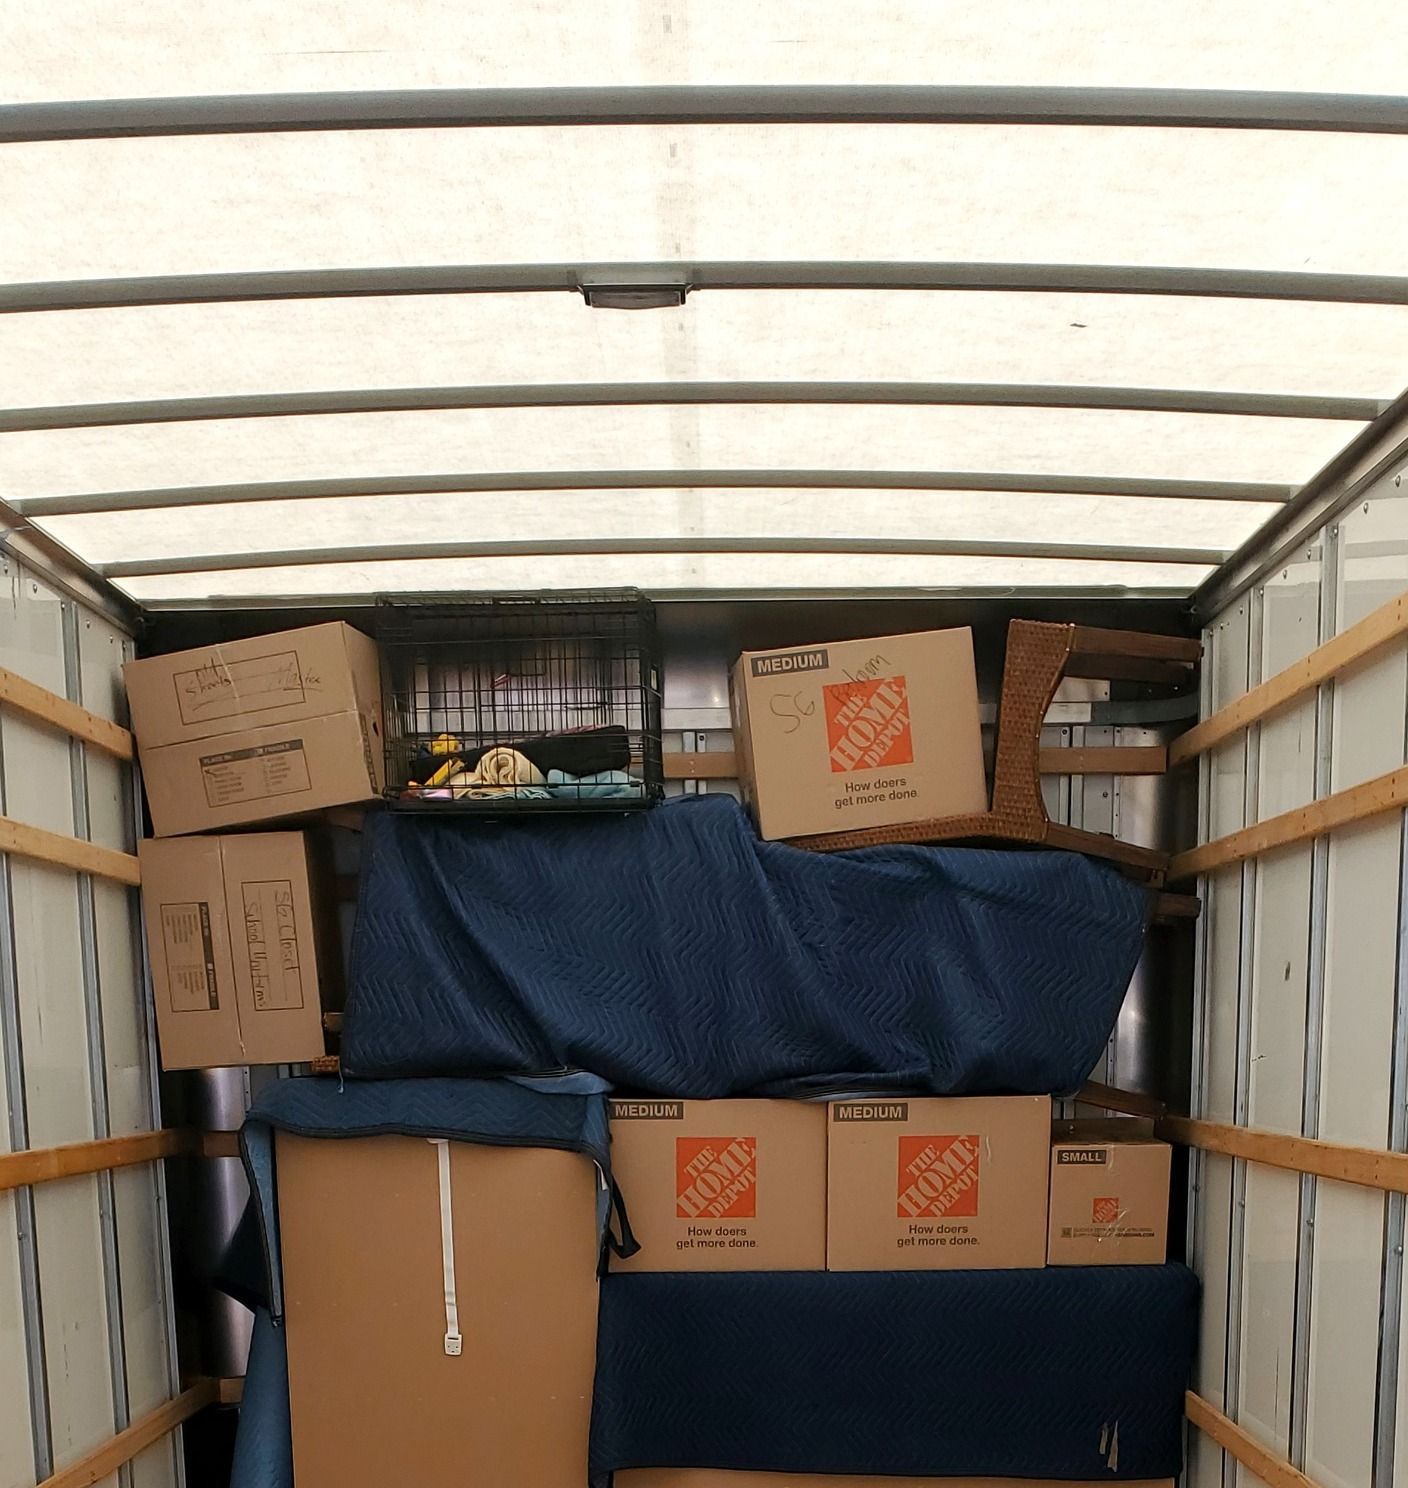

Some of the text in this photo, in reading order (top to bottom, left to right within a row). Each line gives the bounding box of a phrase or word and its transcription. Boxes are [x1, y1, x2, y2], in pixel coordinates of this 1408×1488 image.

[757, 653, 823, 674] MEDIUM
[834, 692, 868, 727] THE
[830, 678, 906, 771] HOME
[863, 709, 910, 768] DEPOT
[845, 777, 907, 793] How doers
[835, 796, 854, 809] get
[856, 793, 886, 805] more
[615, 1104, 678, 1117] MEDIUM
[839, 1106, 902, 1119] MEDIUM
[684, 1146, 717, 1180] THE
[906, 1144, 940, 1177] THE
[1062, 1152, 1102, 1162] SMALL
[677, 1137, 755, 1218] HOME
[898, 1136, 978, 1217] HOME
[707, 1167, 755, 1218] DEPOT
[929, 1166, 978, 1217] DEPOT
[687, 1226, 747, 1236] How doers
[909, 1224, 968, 1234] How doers
[676, 1238, 695, 1249] get
[697, 1239, 726, 1248] more
[897, 1235, 980, 1247] get more done.
